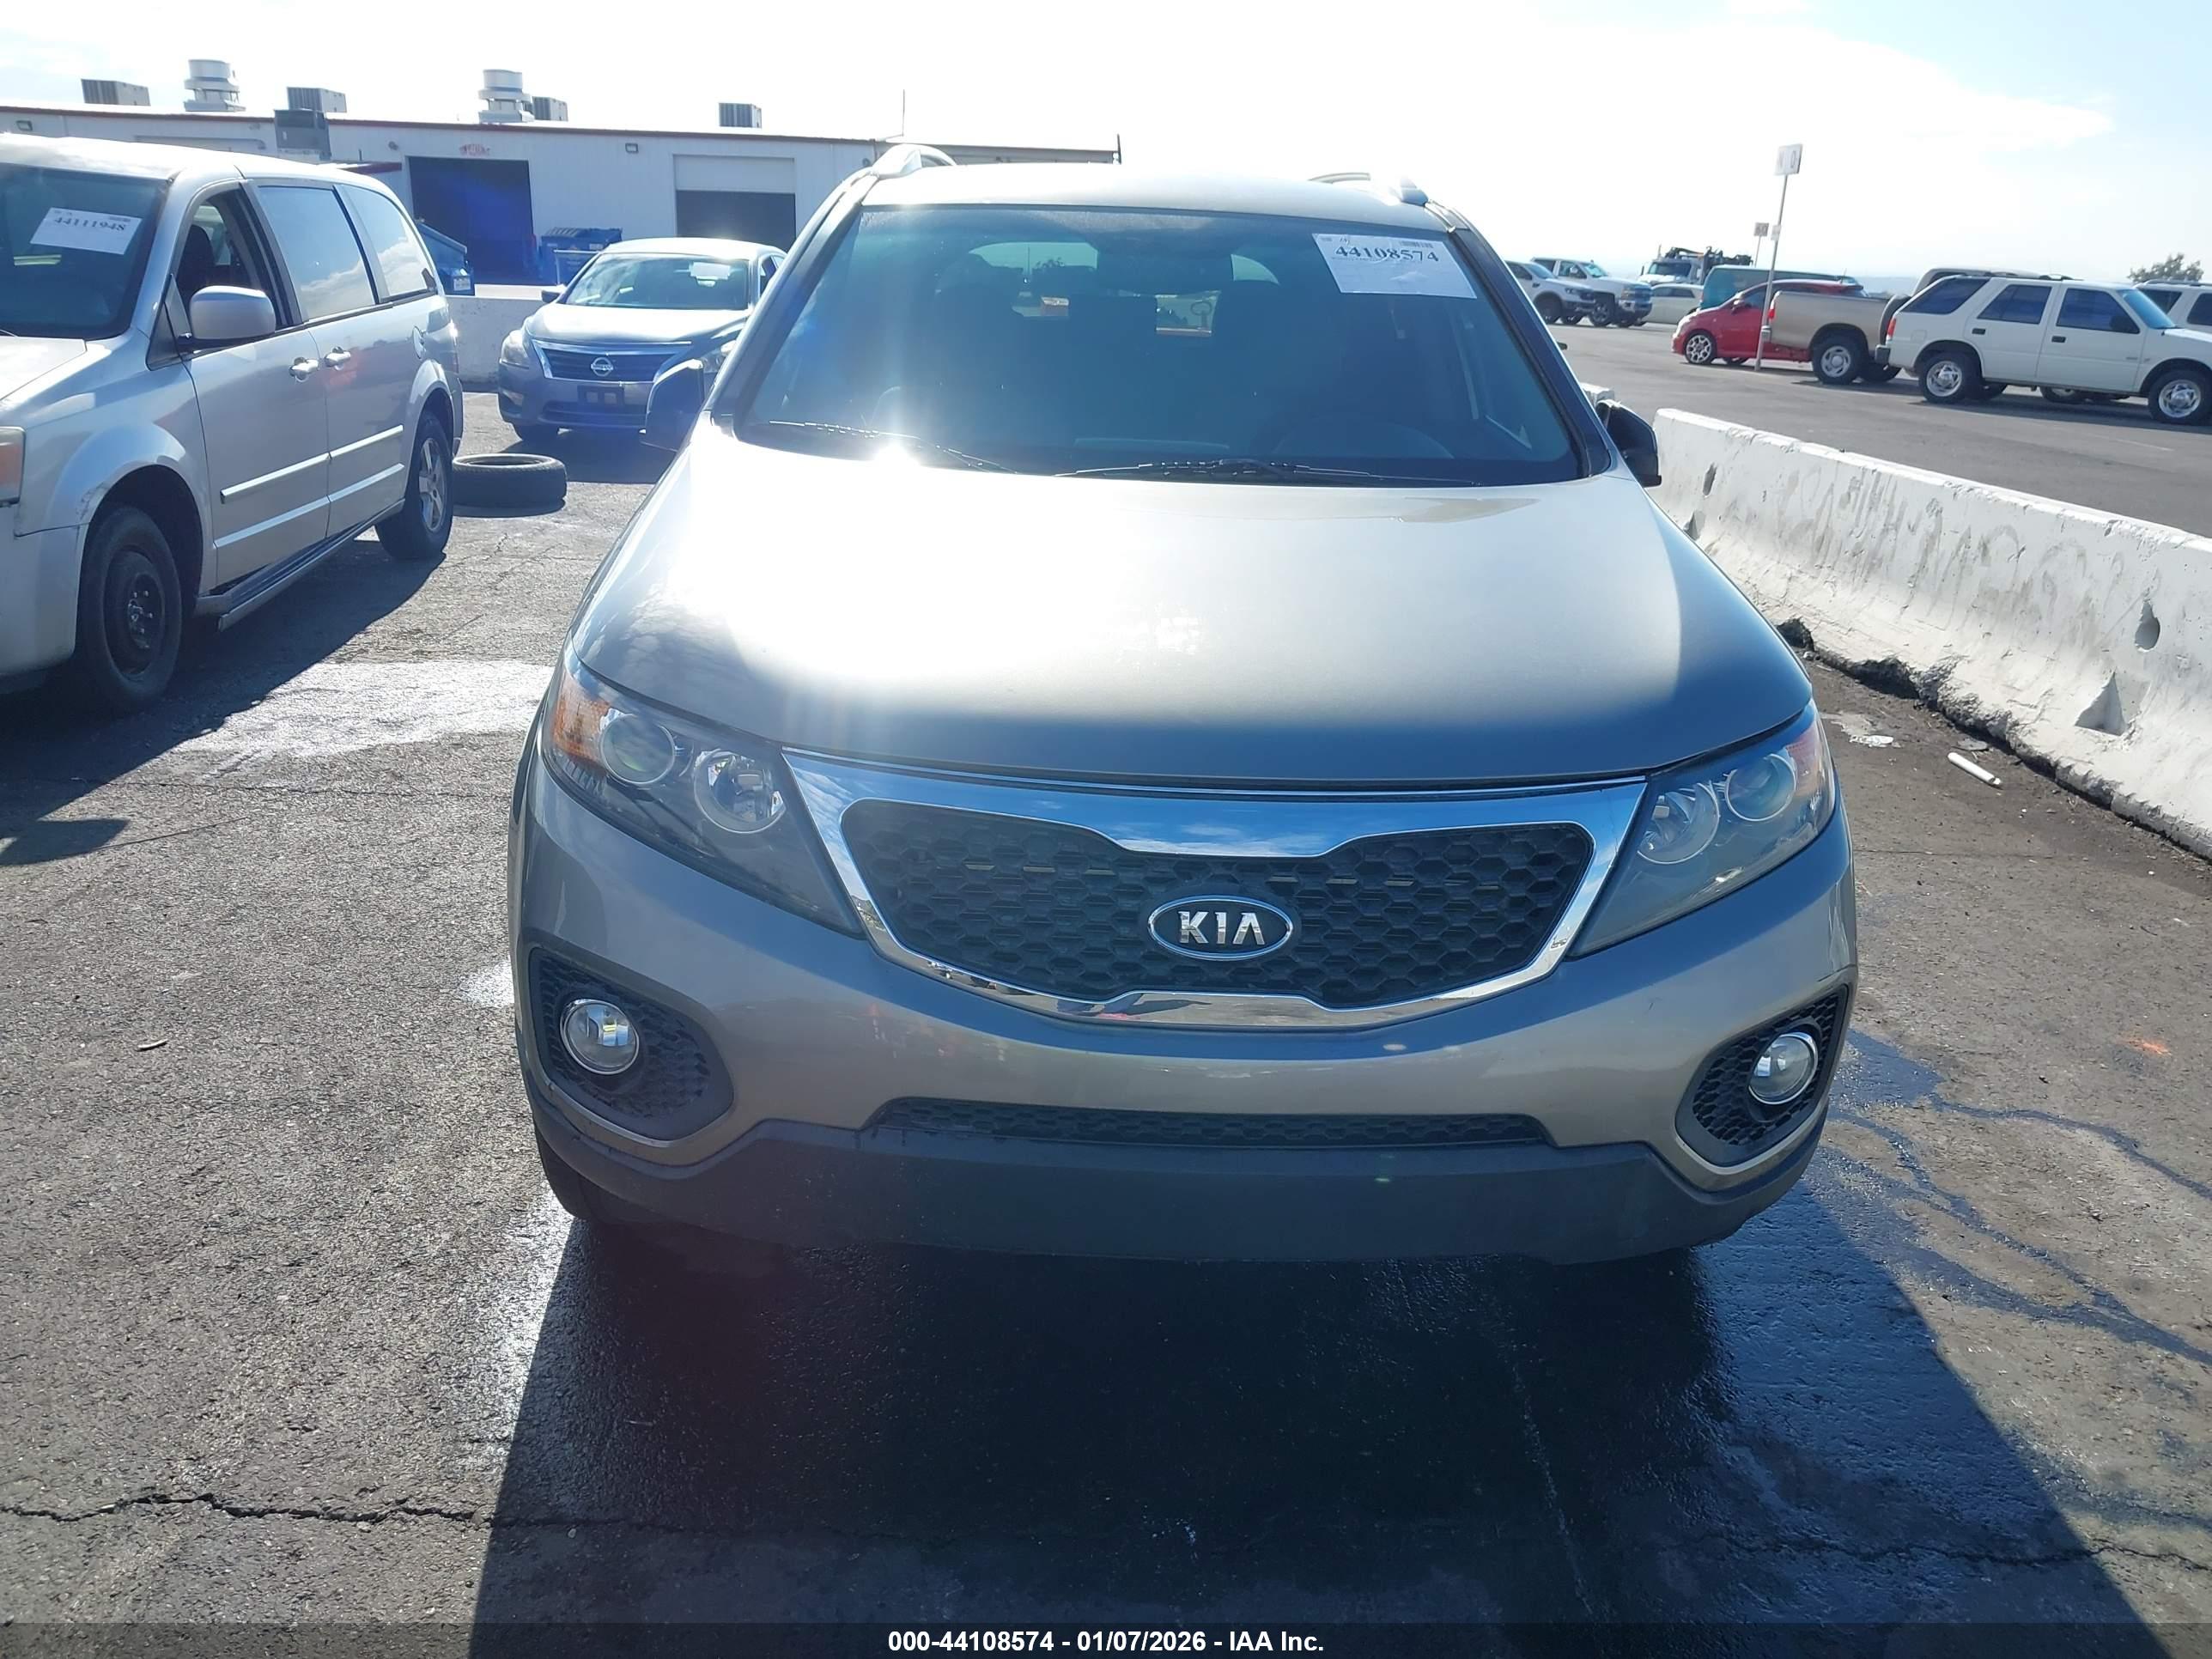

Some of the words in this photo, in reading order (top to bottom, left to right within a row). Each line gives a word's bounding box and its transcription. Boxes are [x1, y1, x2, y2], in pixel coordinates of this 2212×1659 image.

[54, 217, 125, 231] 44111948
[1335, 246, 1439, 262] 44108574
[1178, 911, 1265, 945] KIA
